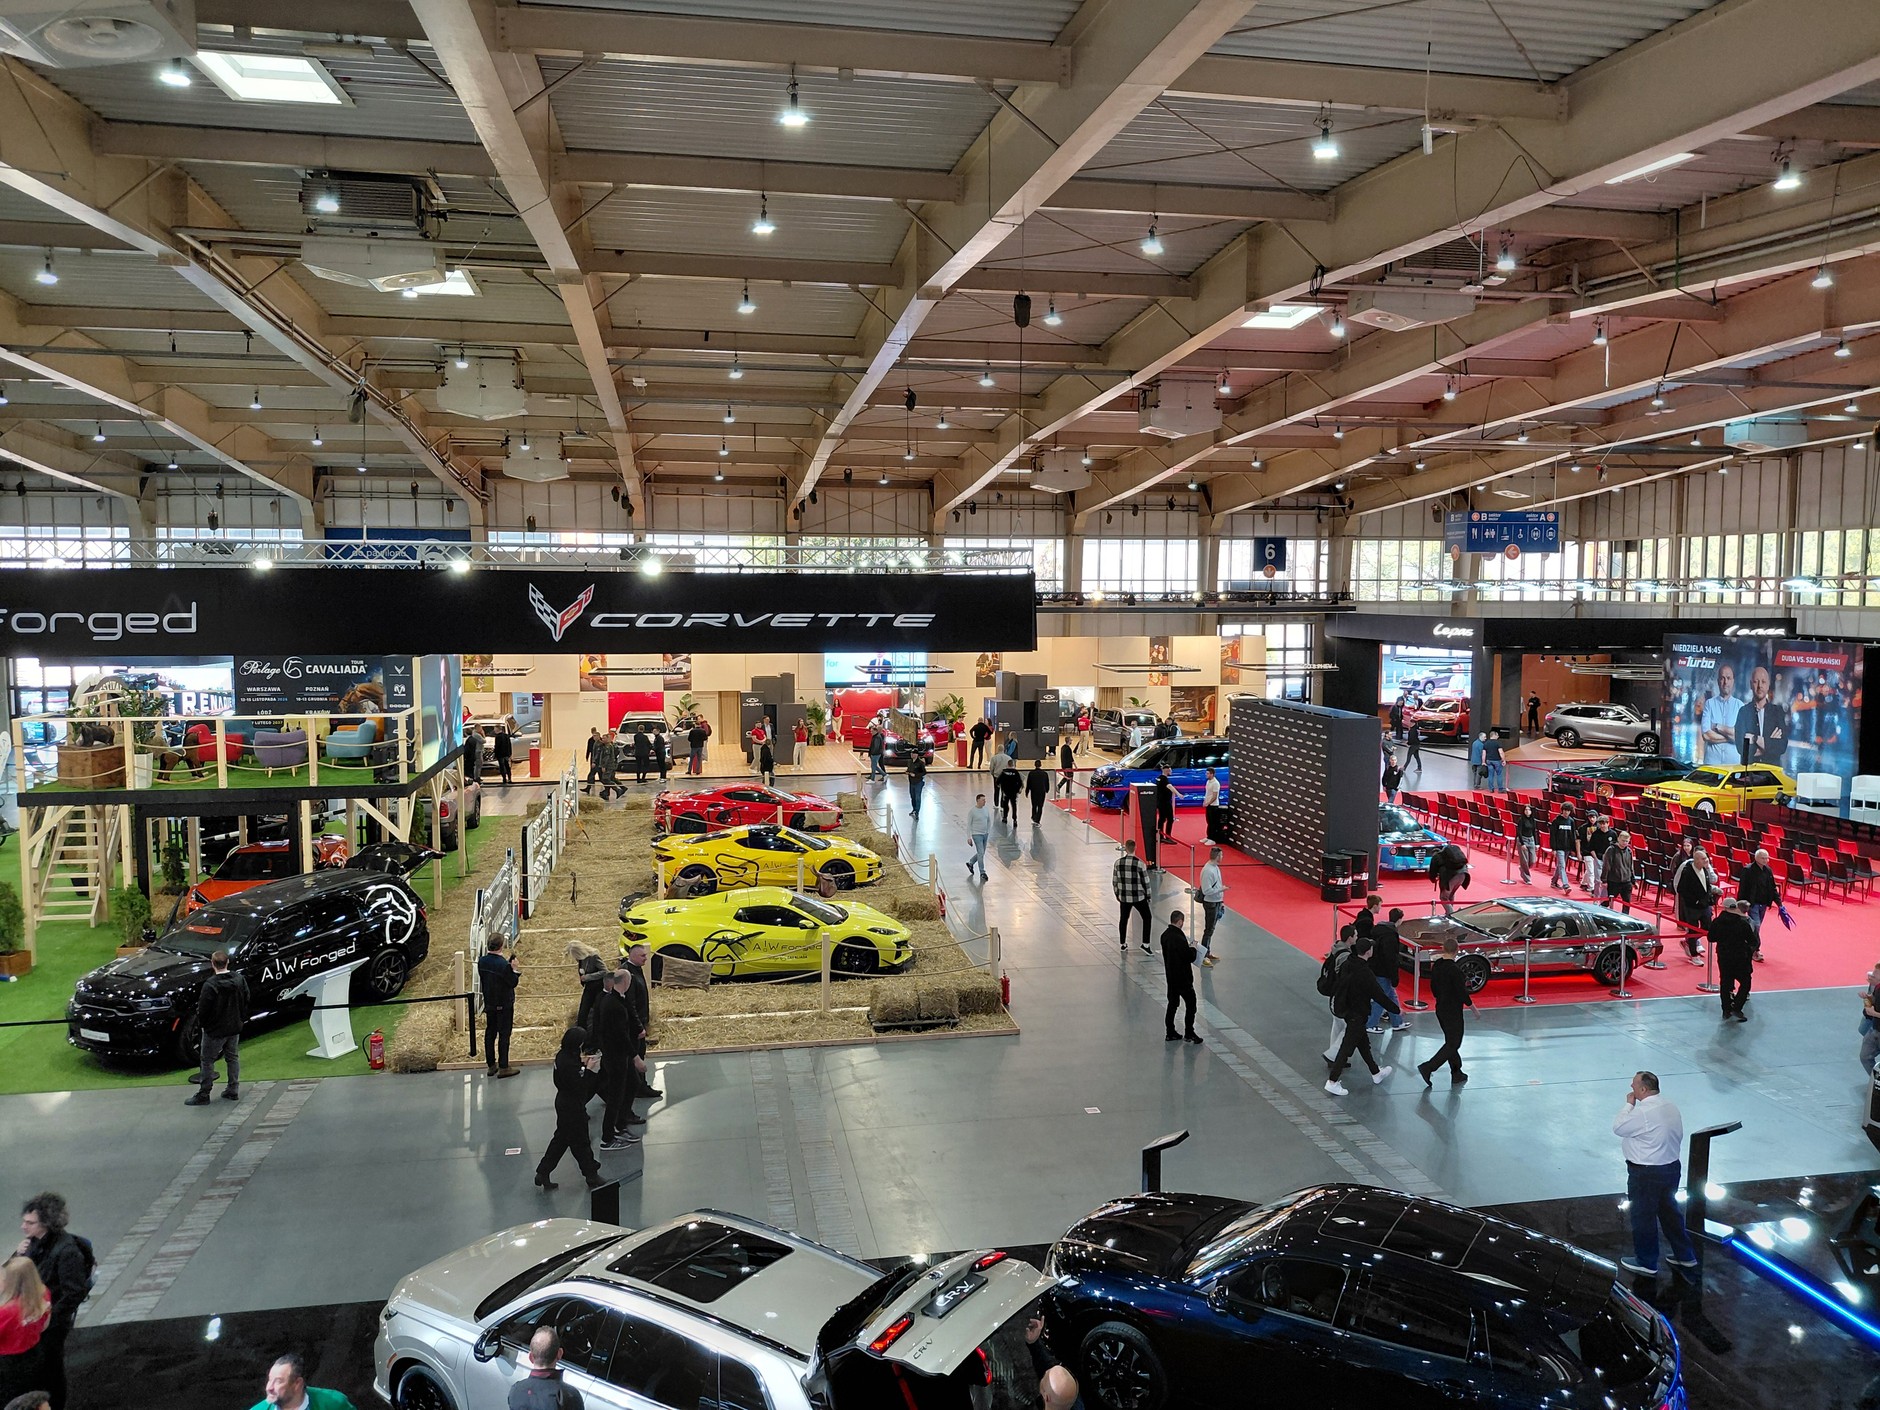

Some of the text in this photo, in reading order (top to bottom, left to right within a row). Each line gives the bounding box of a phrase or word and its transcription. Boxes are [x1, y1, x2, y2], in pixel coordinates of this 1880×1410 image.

[1481, 513, 1488, 521] B
[1539, 513, 1546, 521] A
[1265, 543, 1276, 560] 6
[0, 601, 198, 641] orged
[590, 613, 936, 629] CORVETTE
[1672, 643, 1722, 654] NIEDZIELA 14:45
[306, 664, 366, 674] CAVALIADA
[1806, 656, 1841, 666] SZAFRAŃSKI
[239, 660, 281, 680] Perlage
[300, 942, 355, 970] Forged
[936, 1281, 970, 1307] CR-V
[913, 1338, 933, 1360] CR-V
